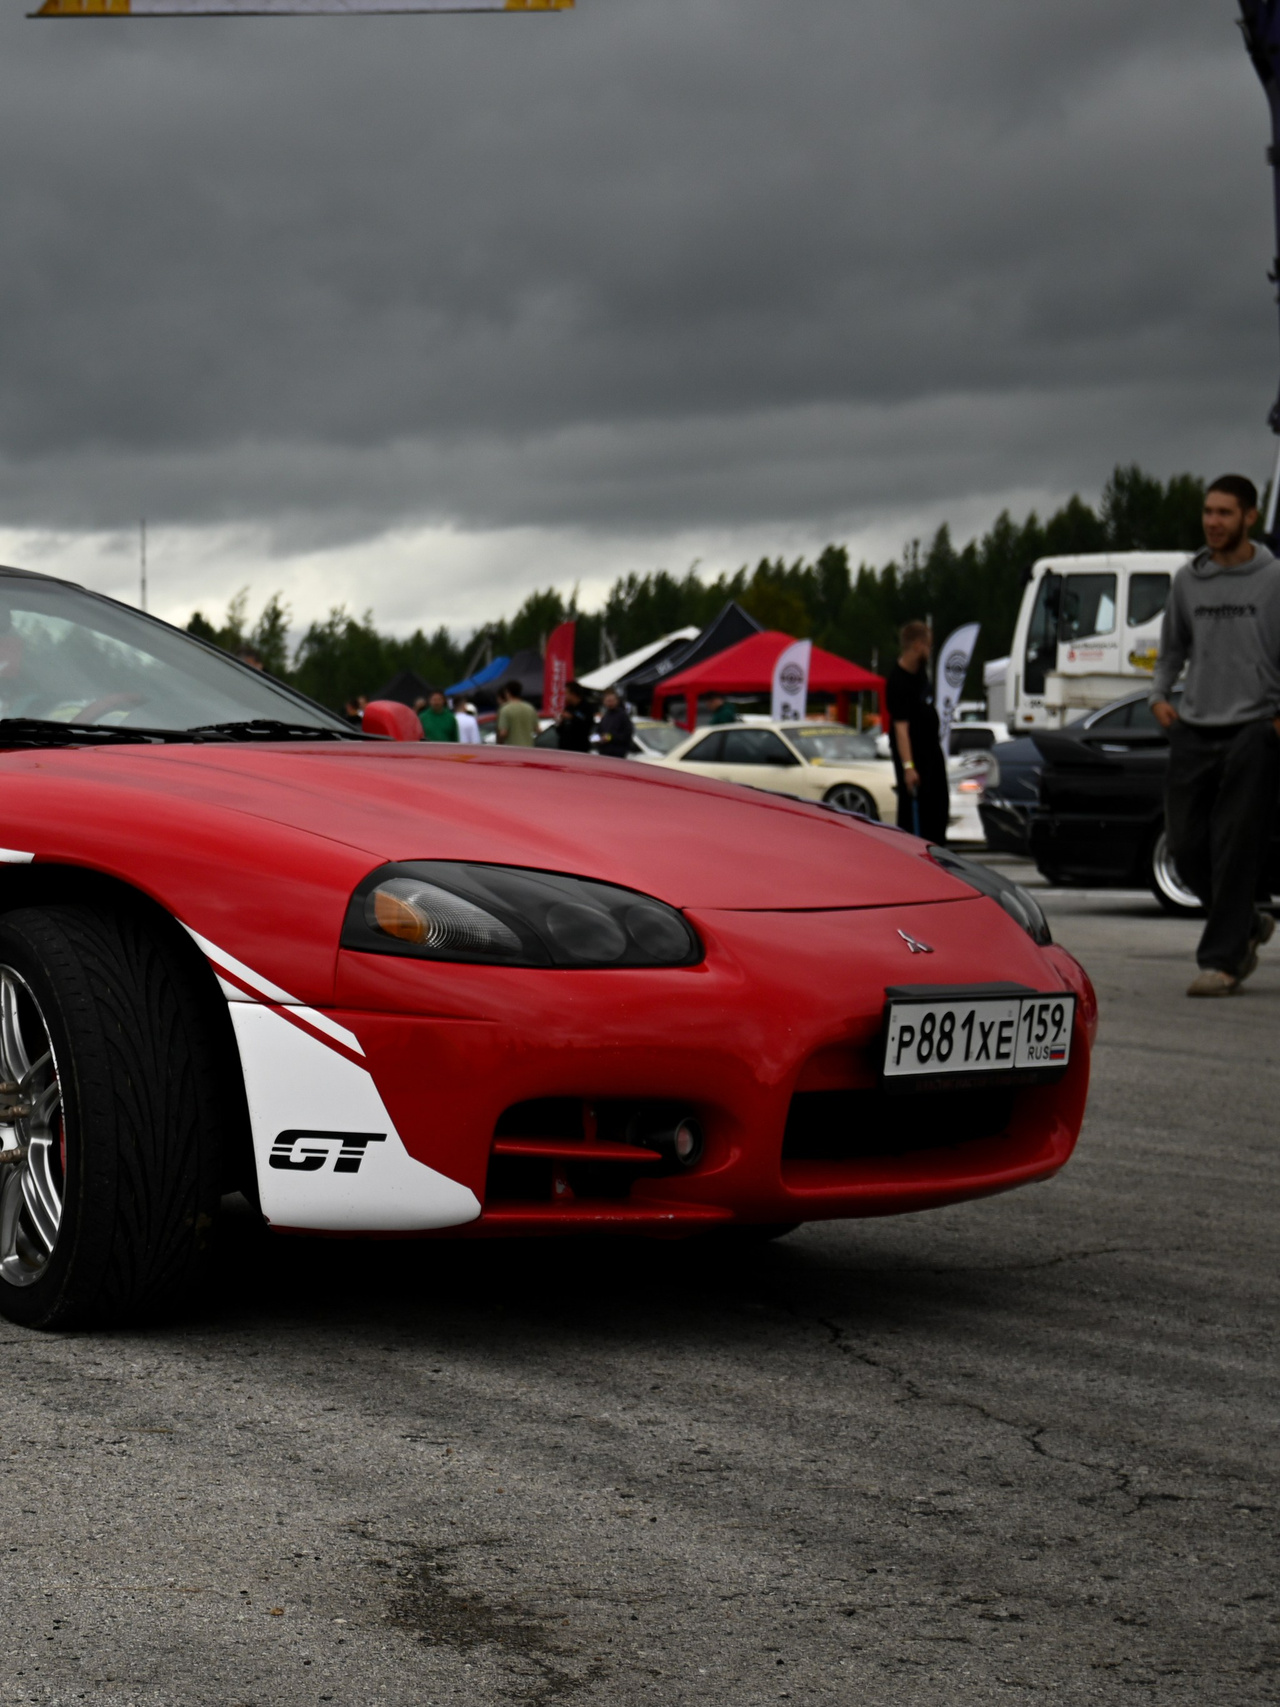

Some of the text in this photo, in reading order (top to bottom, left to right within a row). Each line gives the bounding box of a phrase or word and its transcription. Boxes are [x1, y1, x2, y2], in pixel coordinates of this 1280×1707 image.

[1022, 1003, 1064, 1043] 159
[1027, 1045, 1049, 1060] RUS
[269, 1129, 388, 1173] GT
